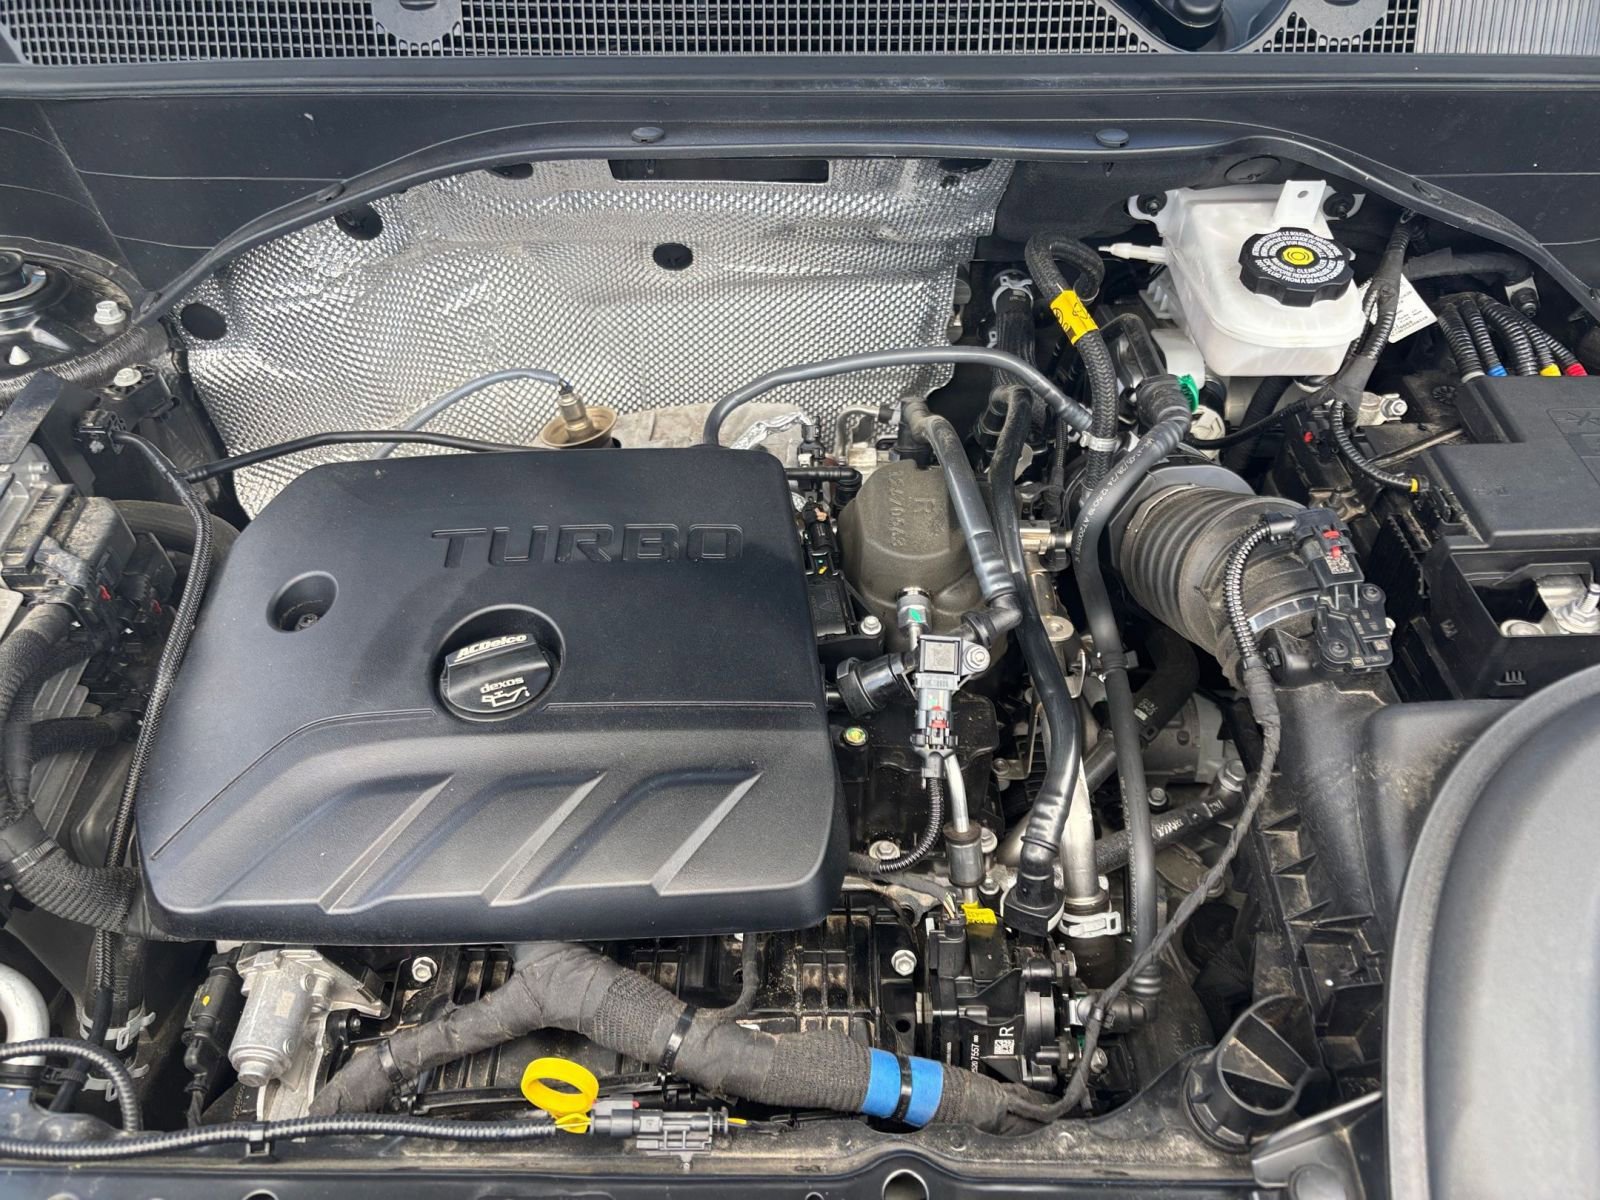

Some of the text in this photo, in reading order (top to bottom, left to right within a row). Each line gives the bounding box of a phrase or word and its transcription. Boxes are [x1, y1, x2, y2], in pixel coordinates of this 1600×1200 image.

[432, 523, 744, 568] TURBO
[456, 634, 528, 660] ACDelco
[480, 676, 525, 694] dexos
[999, 1026, 1015, 1037] R
